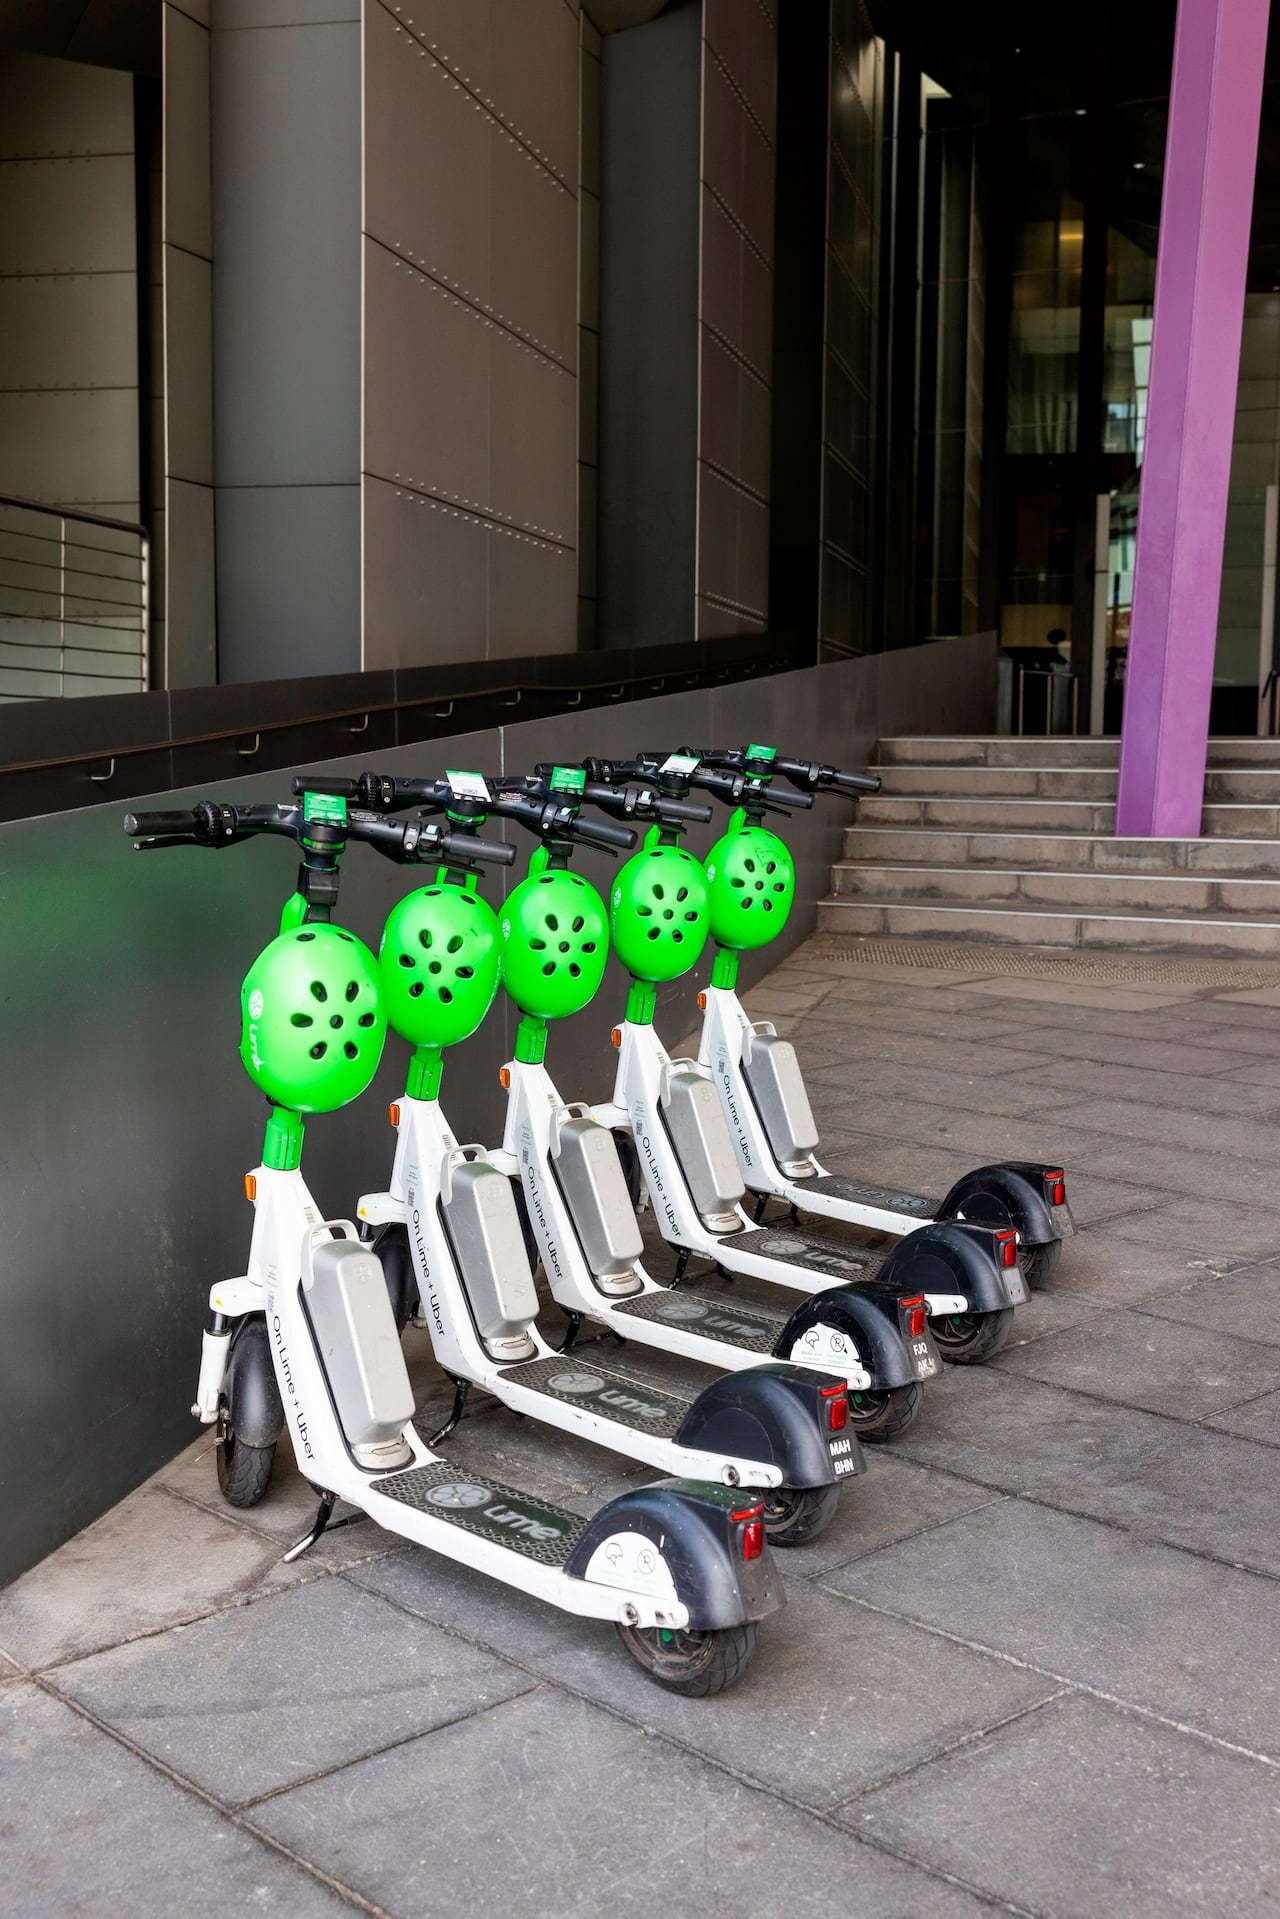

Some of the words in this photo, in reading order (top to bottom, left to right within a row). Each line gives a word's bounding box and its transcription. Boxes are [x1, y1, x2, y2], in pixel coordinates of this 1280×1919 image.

[722, 1074, 732, 1095] On
[727, 1094, 740, 1126] Lime
[739, 1136, 753, 1167] Uber
[642, 1136, 652, 1159] On
[648, 1158, 664, 1192] Lime
[664, 1203, 682, 1237] Uber
[527, 1166, 536, 1190] On
[532, 1190, 547, 1228] Lime
[547, 1240, 563, 1278] Uber
[412, 1209, 420, 1236] On
[416, 1237, 430, 1279] Lime
[430, 1294, 445, 1337] Uber
[913, 1342, 928, 1356] FJQ
[273, 1315, 283, 1345] On
[279, 1346, 295, 1394] Lime
[296, 1412, 315, 1461] Uber
[598, 1389, 668, 1418] Lime
[830, 1439, 851, 1456] MAH
[834, 1458, 854, 1474] BHN
[483, 1504, 562, 1541] Lime
